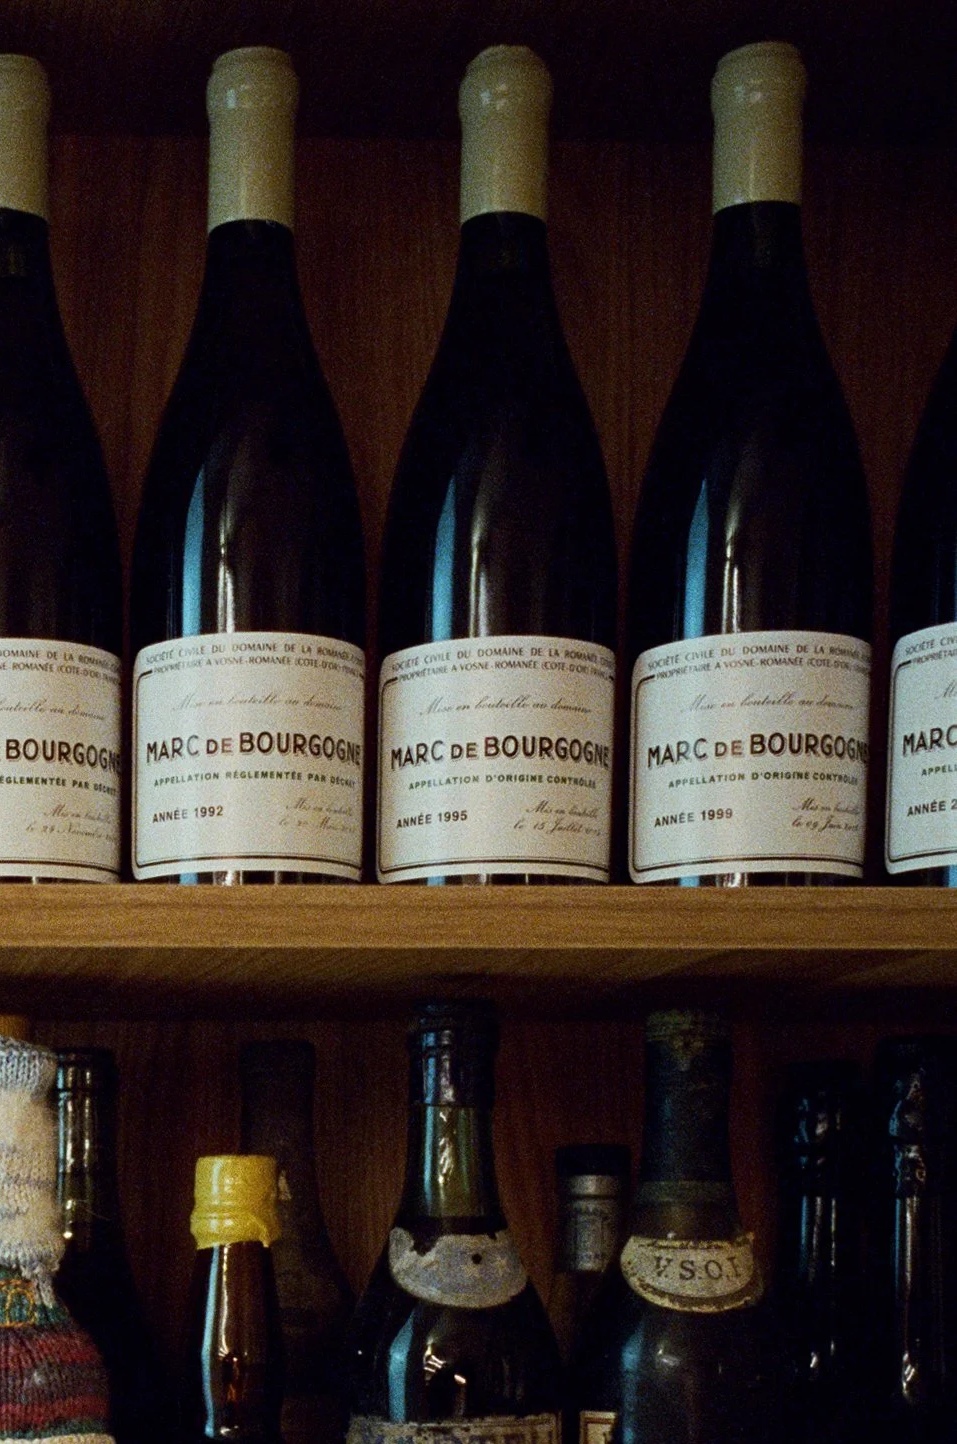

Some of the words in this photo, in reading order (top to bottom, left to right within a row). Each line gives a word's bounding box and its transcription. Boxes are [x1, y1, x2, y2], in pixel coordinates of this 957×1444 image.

[456, 649, 472, 659] DU
[476, 647, 524, 658] DOMAINE
[530, 647, 543, 657] DE
[547, 648, 560, 658] LA
[720, 647, 735, 657] DU
[743, 644, 790, 655] DOMAINE
[796, 644, 809, 654] DE
[813, 645, 825, 655] LA
[146, 735, 200, 766] MARC
[205, 737, 234, 755] DE
[239, 731, 361, 767] BOURGOGNE
[902, 725, 957, 757] MARC
[392, 740, 444, 770] MARC
[450, 743, 478, 761] DE
[484, 735, 610, 770] BOURGOGNE
[648, 738, 708, 768] MARC
[714, 740, 743, 758] DE
[72, 779, 91, 790] PAR
[154, 771, 220, 788] APPELLATION
[225, 770, 303, 782] RÉGLEMENTÉE
[307, 773, 327, 783] PAR
[408, 776, 480, 790] APPELLATION
[485, 774, 543, 784] D'ORIGINE
[668, 773, 746, 789] APPELLATION
[751, 771, 810, 781] D'ORIGINE
[152, 807, 190, 824] ANNÉE
[194, 805, 225, 819] 1992
[654, 812, 695, 828] ANNÉE
[700, 808, 734, 822] 1999
[907, 800, 947, 818] ANNÉE
[396, 813, 432, 829] ANNÉE
[437, 810, 468, 823] 1995
